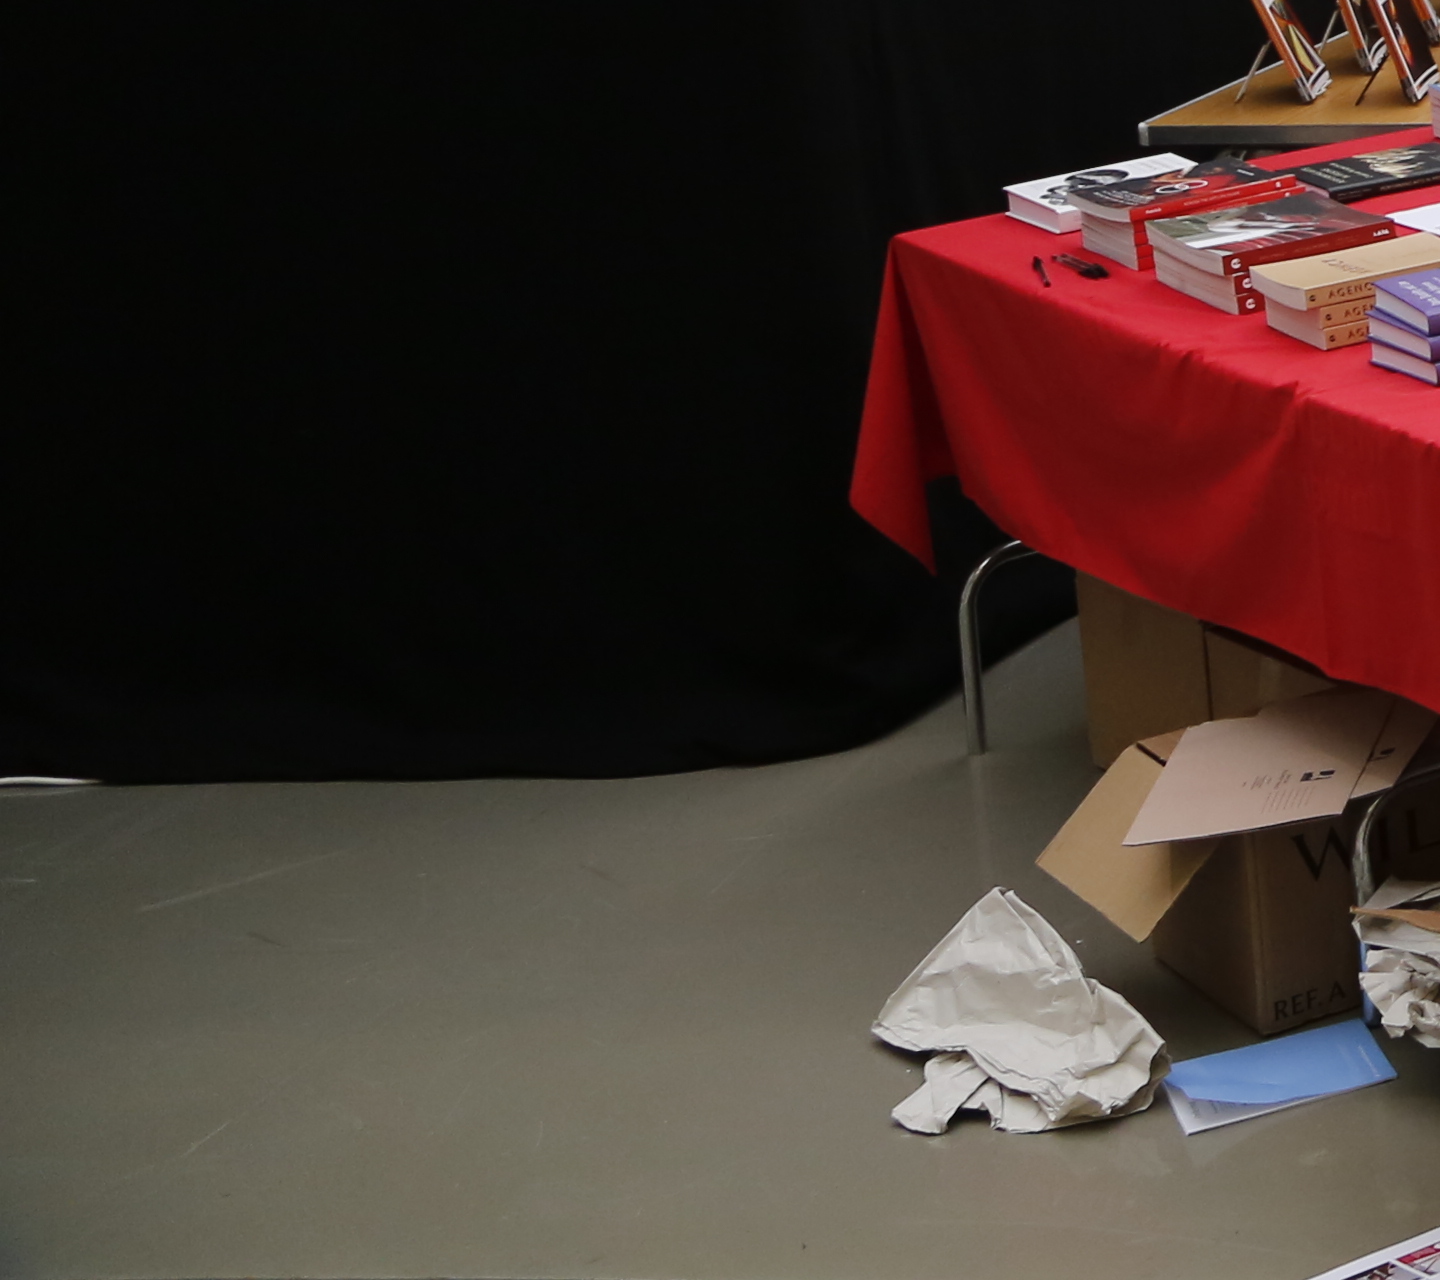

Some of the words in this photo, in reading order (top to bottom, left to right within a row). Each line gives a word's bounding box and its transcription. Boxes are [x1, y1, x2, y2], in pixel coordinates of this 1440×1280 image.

[1328, 282, 1374, 300] AGENC
[1344, 304, 1376, 318] AGE
[1274, 989, 1321, 1021] REF.
[1328, 980, 1347, 1002] A
